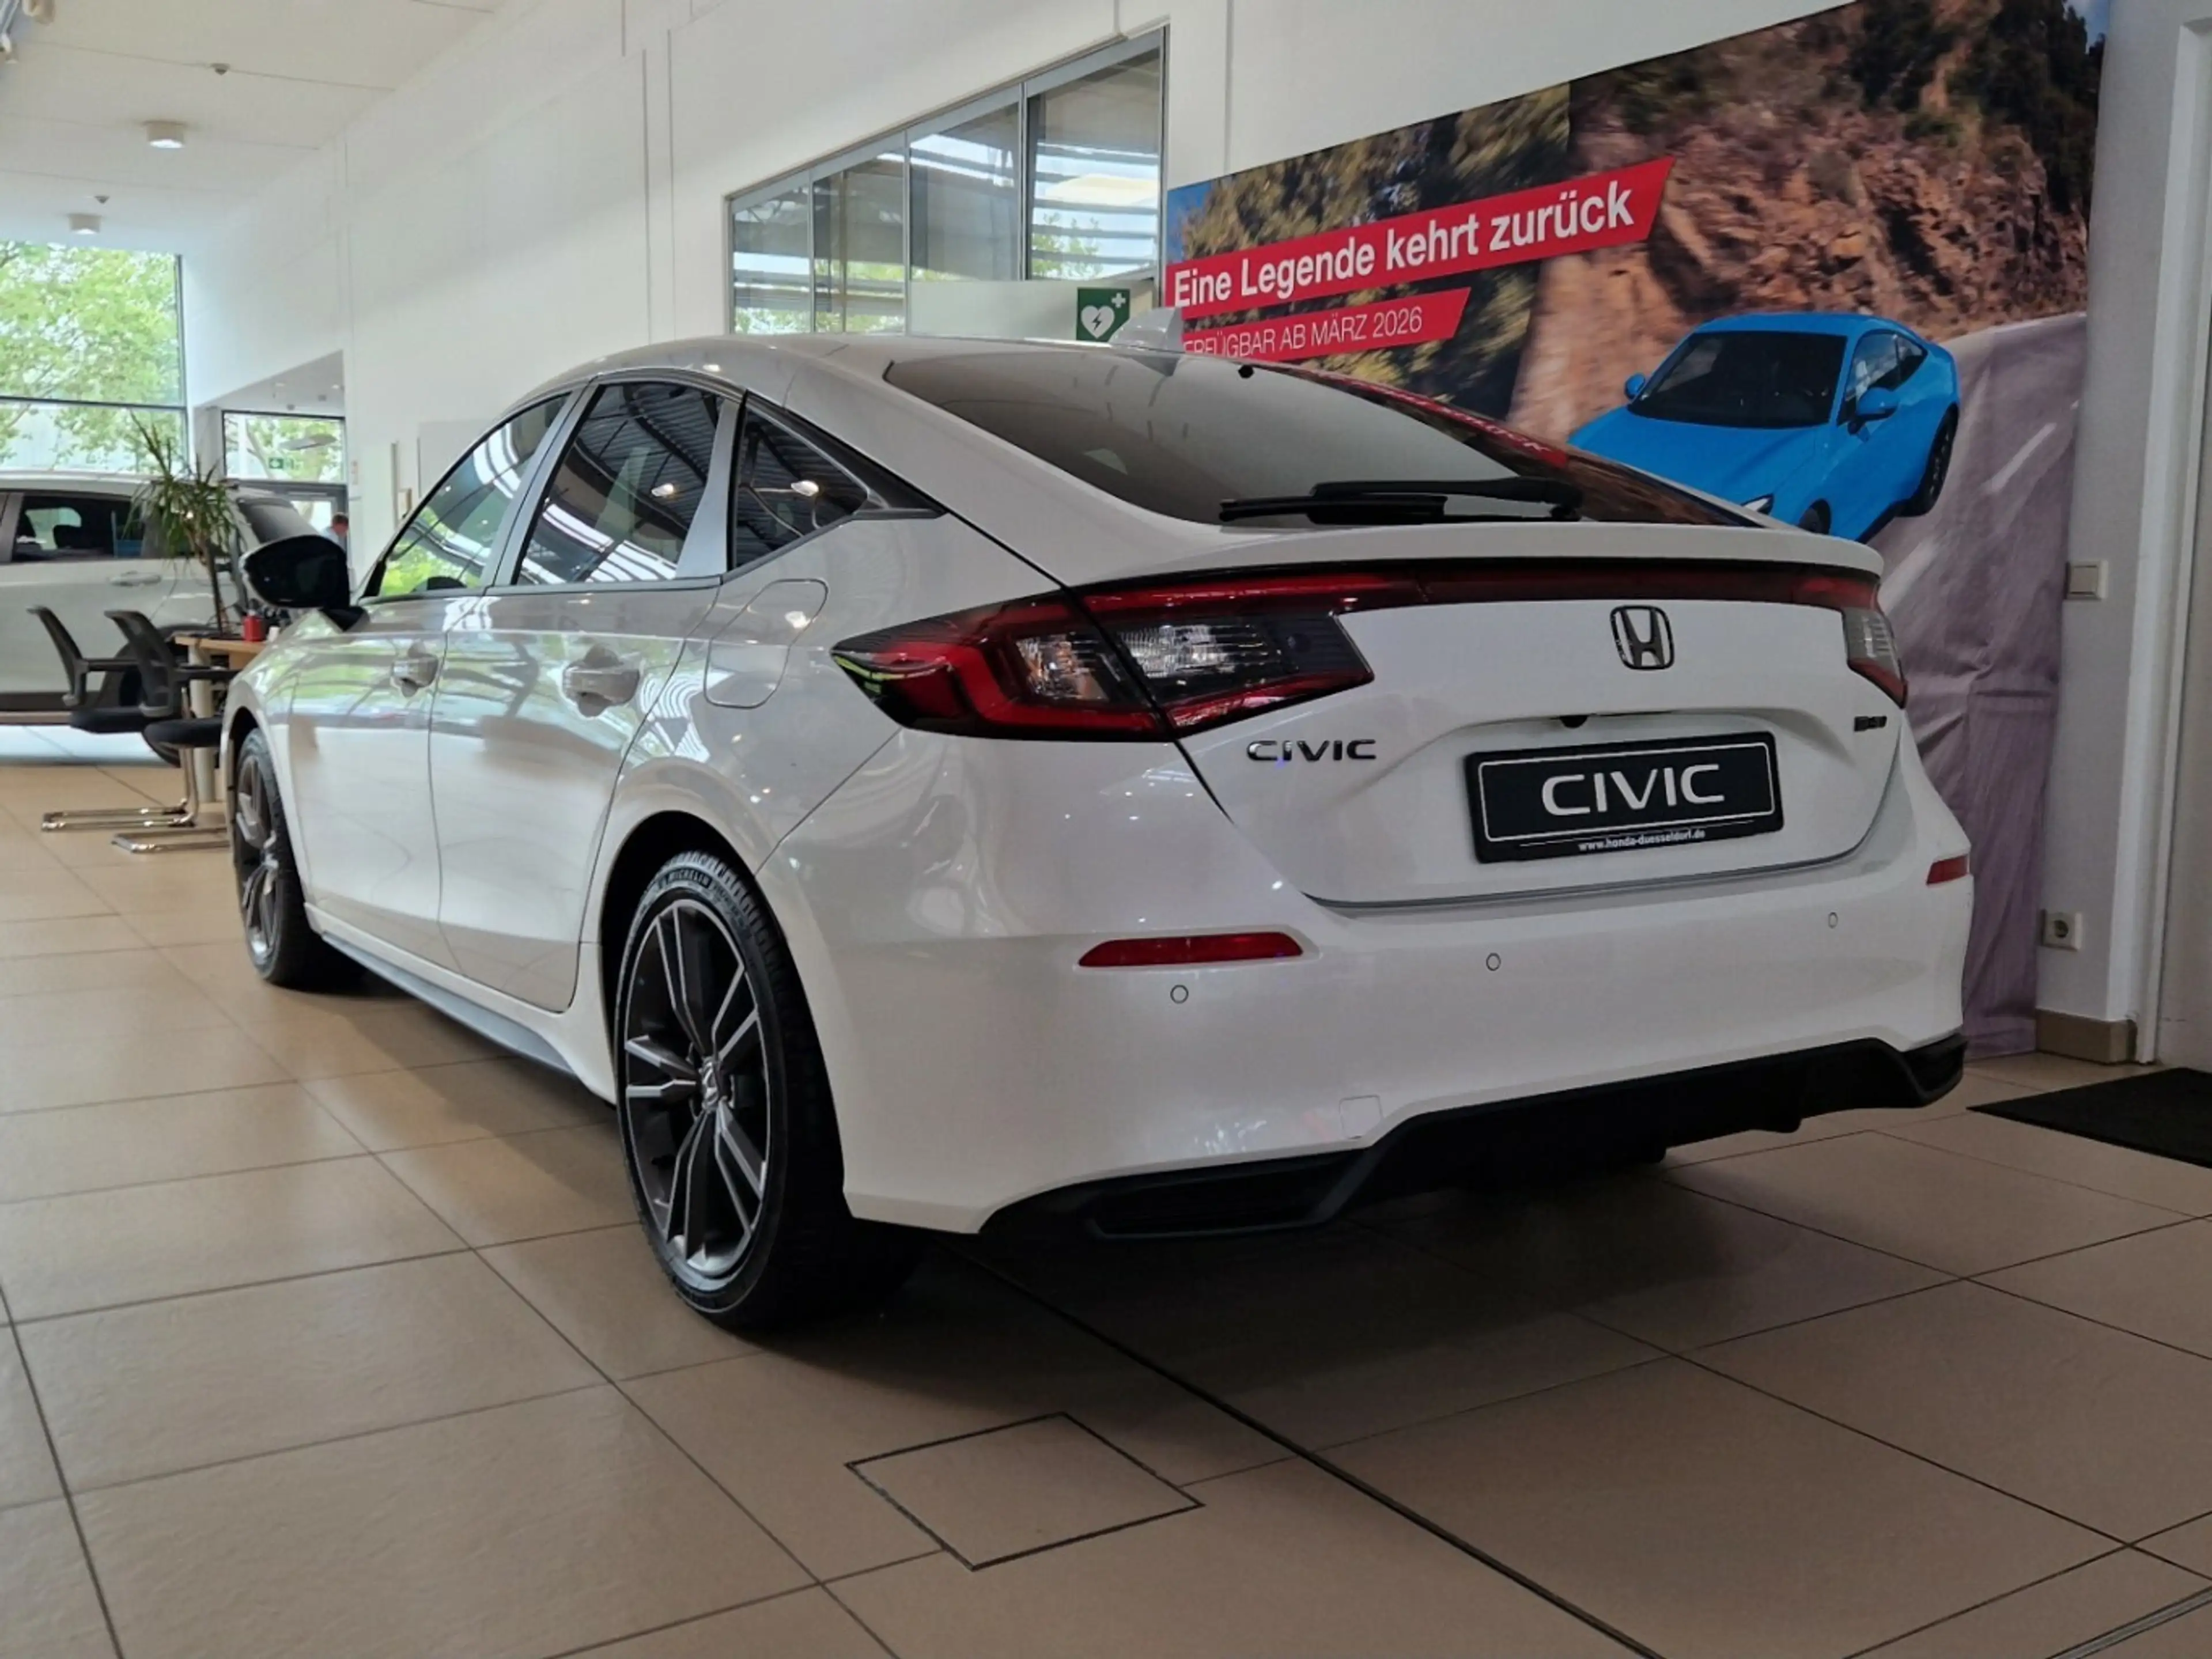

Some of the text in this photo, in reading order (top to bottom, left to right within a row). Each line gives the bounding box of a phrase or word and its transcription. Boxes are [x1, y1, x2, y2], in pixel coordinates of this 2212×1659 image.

[1174, 180, 1635, 308] Eine Legende kehrt zurück
[1183, 306, 1423, 358] RFÜGBAR AB MÄRZ 2026
[1246, 739, 1377, 762] CIVIC
[1542, 764, 1725, 816] CIVIC
[1578, 828, 1706, 851] www.honda-duesseldorf.de
